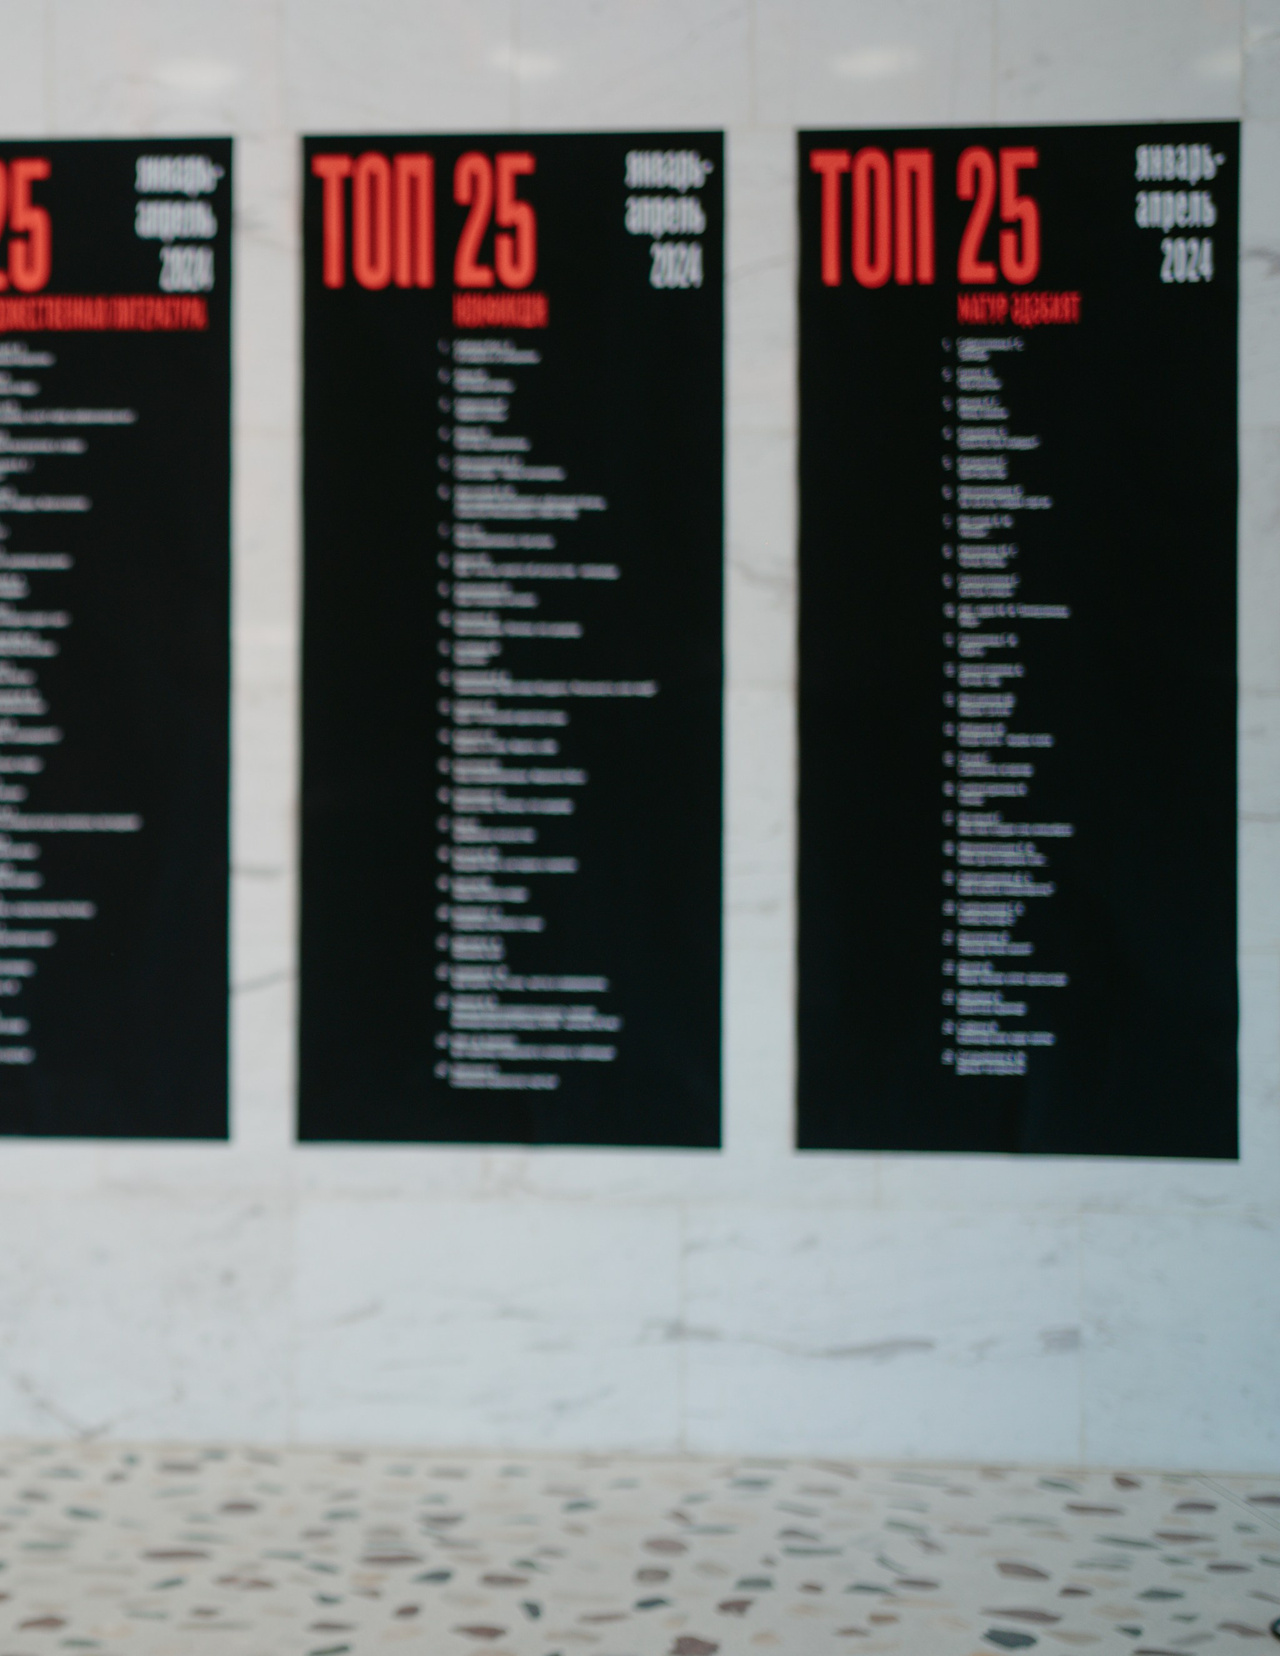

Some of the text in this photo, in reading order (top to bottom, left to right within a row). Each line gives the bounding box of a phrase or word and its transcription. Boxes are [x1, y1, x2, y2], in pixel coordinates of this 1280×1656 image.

[312, 151, 537, 290] ТОП 25
[810, 146, 1041, 287] ТОП 25
[1135, 190, 1217, 234] апрель
[1160, 236, 1214, 283] 2024
